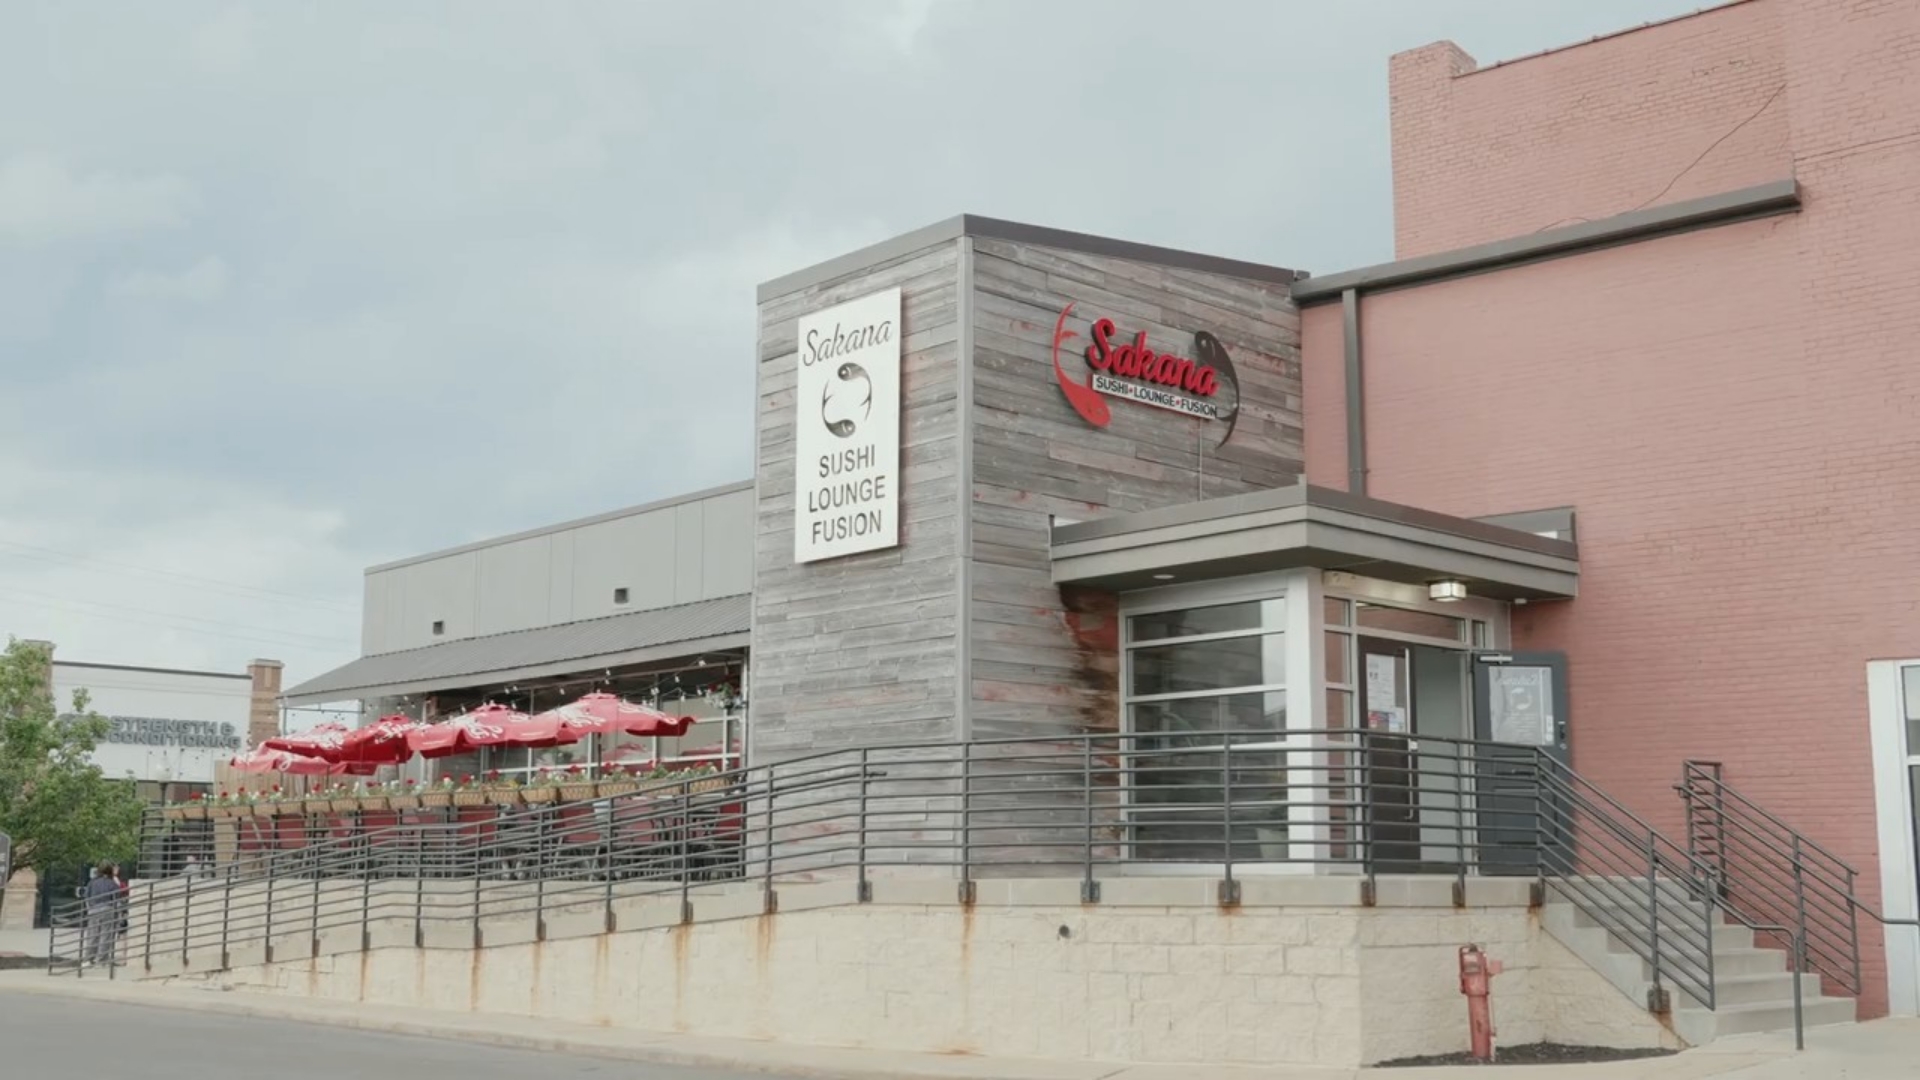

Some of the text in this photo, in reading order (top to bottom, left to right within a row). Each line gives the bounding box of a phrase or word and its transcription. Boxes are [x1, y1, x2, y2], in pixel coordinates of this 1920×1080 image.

[802, 319, 893, 366] Sakana
[1086, 317, 1221, 396] Sakana
[819, 444, 875, 478] SUSHI
[808, 475, 886, 512] LOUNGE
[812, 509, 882, 545] FUSION
[109, 732, 241, 748] CONDITIONING
[110, 716, 235, 736] STRENGTH &
